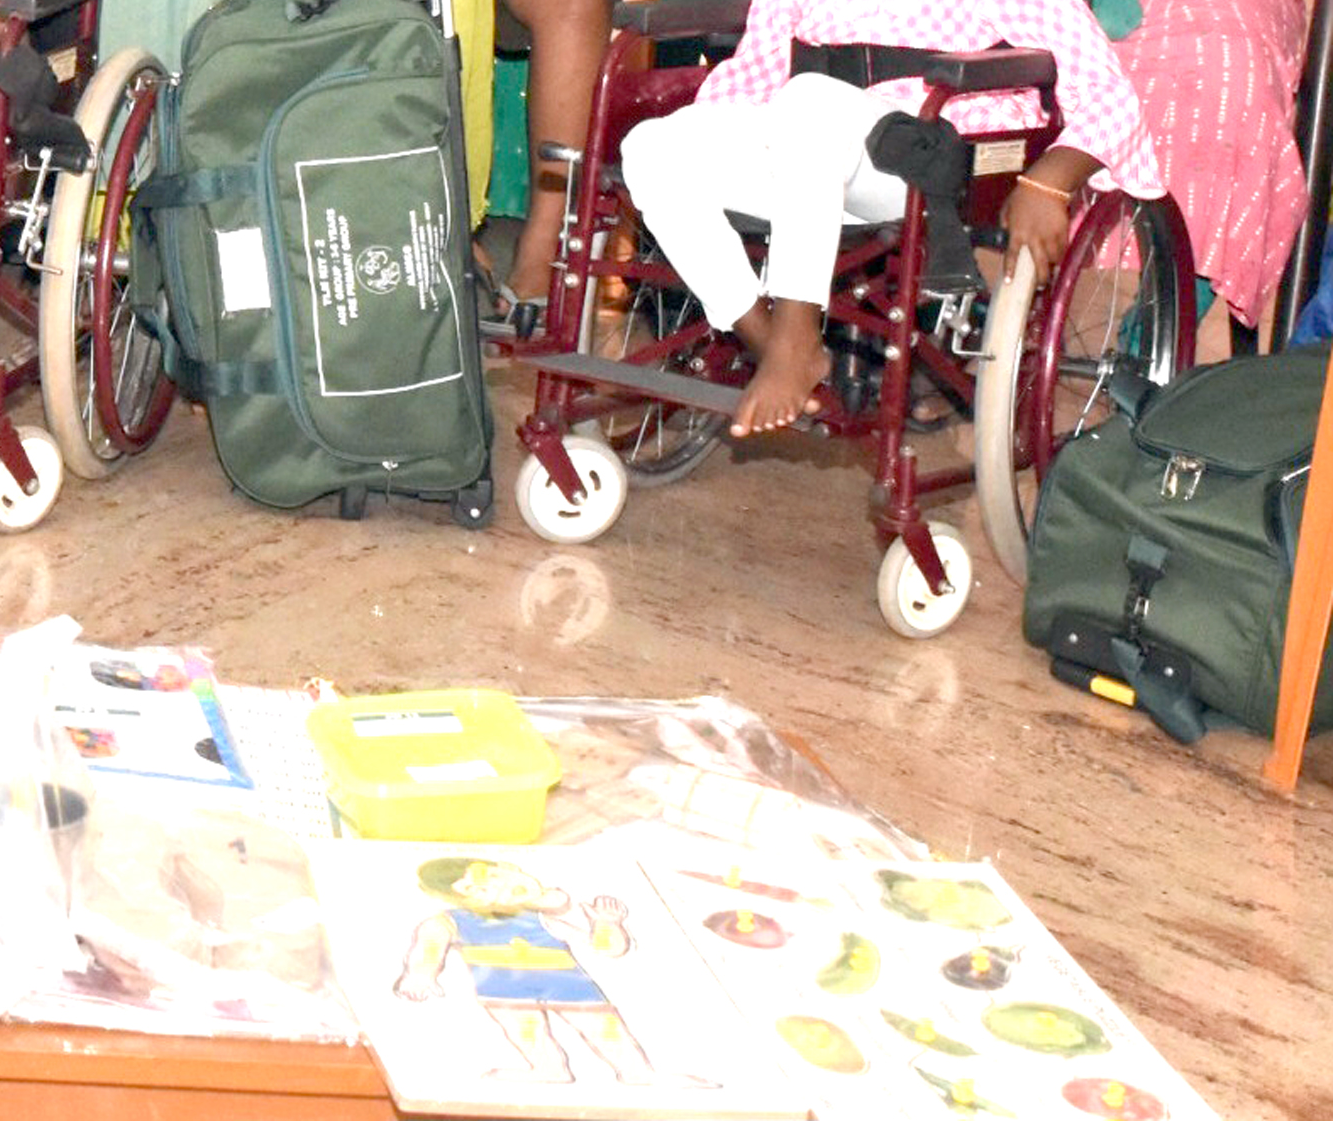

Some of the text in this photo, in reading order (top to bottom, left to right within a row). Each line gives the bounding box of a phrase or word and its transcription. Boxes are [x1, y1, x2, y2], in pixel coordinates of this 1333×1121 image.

[326, 208, 337, 241] YEARS
[338, 215, 351, 250] GROUP
[315, 239, 325, 247] 2
[333, 266, 344, 300] GROUP
